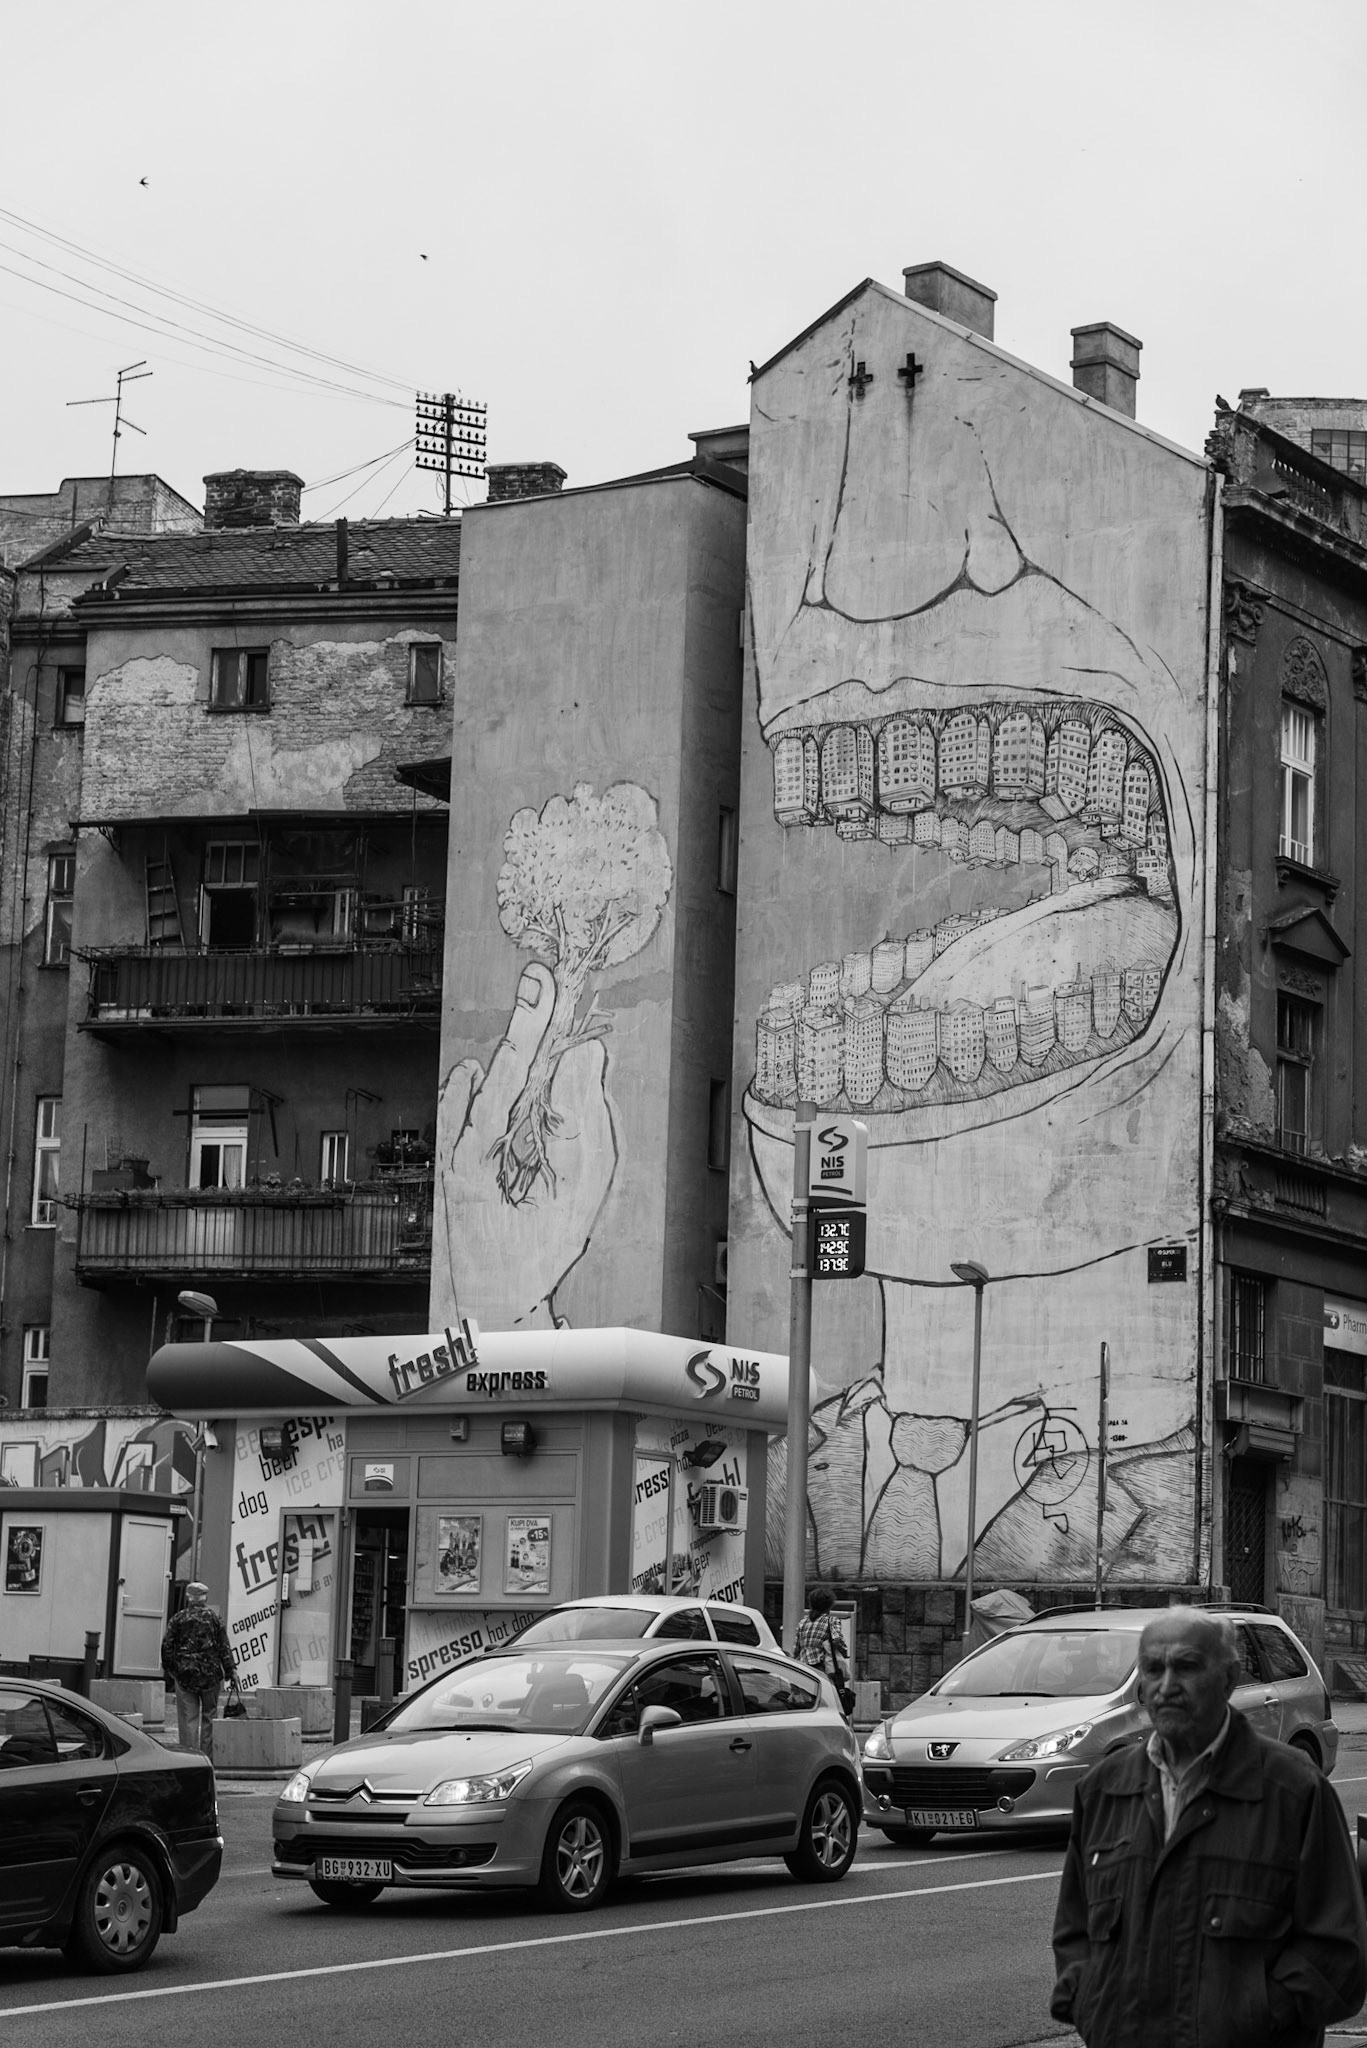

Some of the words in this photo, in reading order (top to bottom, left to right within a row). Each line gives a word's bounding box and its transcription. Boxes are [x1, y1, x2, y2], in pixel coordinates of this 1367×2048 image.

[821, 1156, 844, 1169] NIS
[822, 1170, 842, 1178] PETROL
[388, 1318, 479, 1396] fresh!
[732, 1358, 760, 1384] NIS
[466, 1370, 548, 1398] express
[733, 1387, 758, 1400] PETROL
[670, 1429, 690, 1452] pizza
[283, 1469, 313, 1497] ice
[238, 1491, 270, 1519] dog
[408, 1630, 484, 1682] spresso
[486, 1622, 510, 1645] hot
[913, 1812, 926, 1825] KI
[324, 1860, 339, 1875] BG
